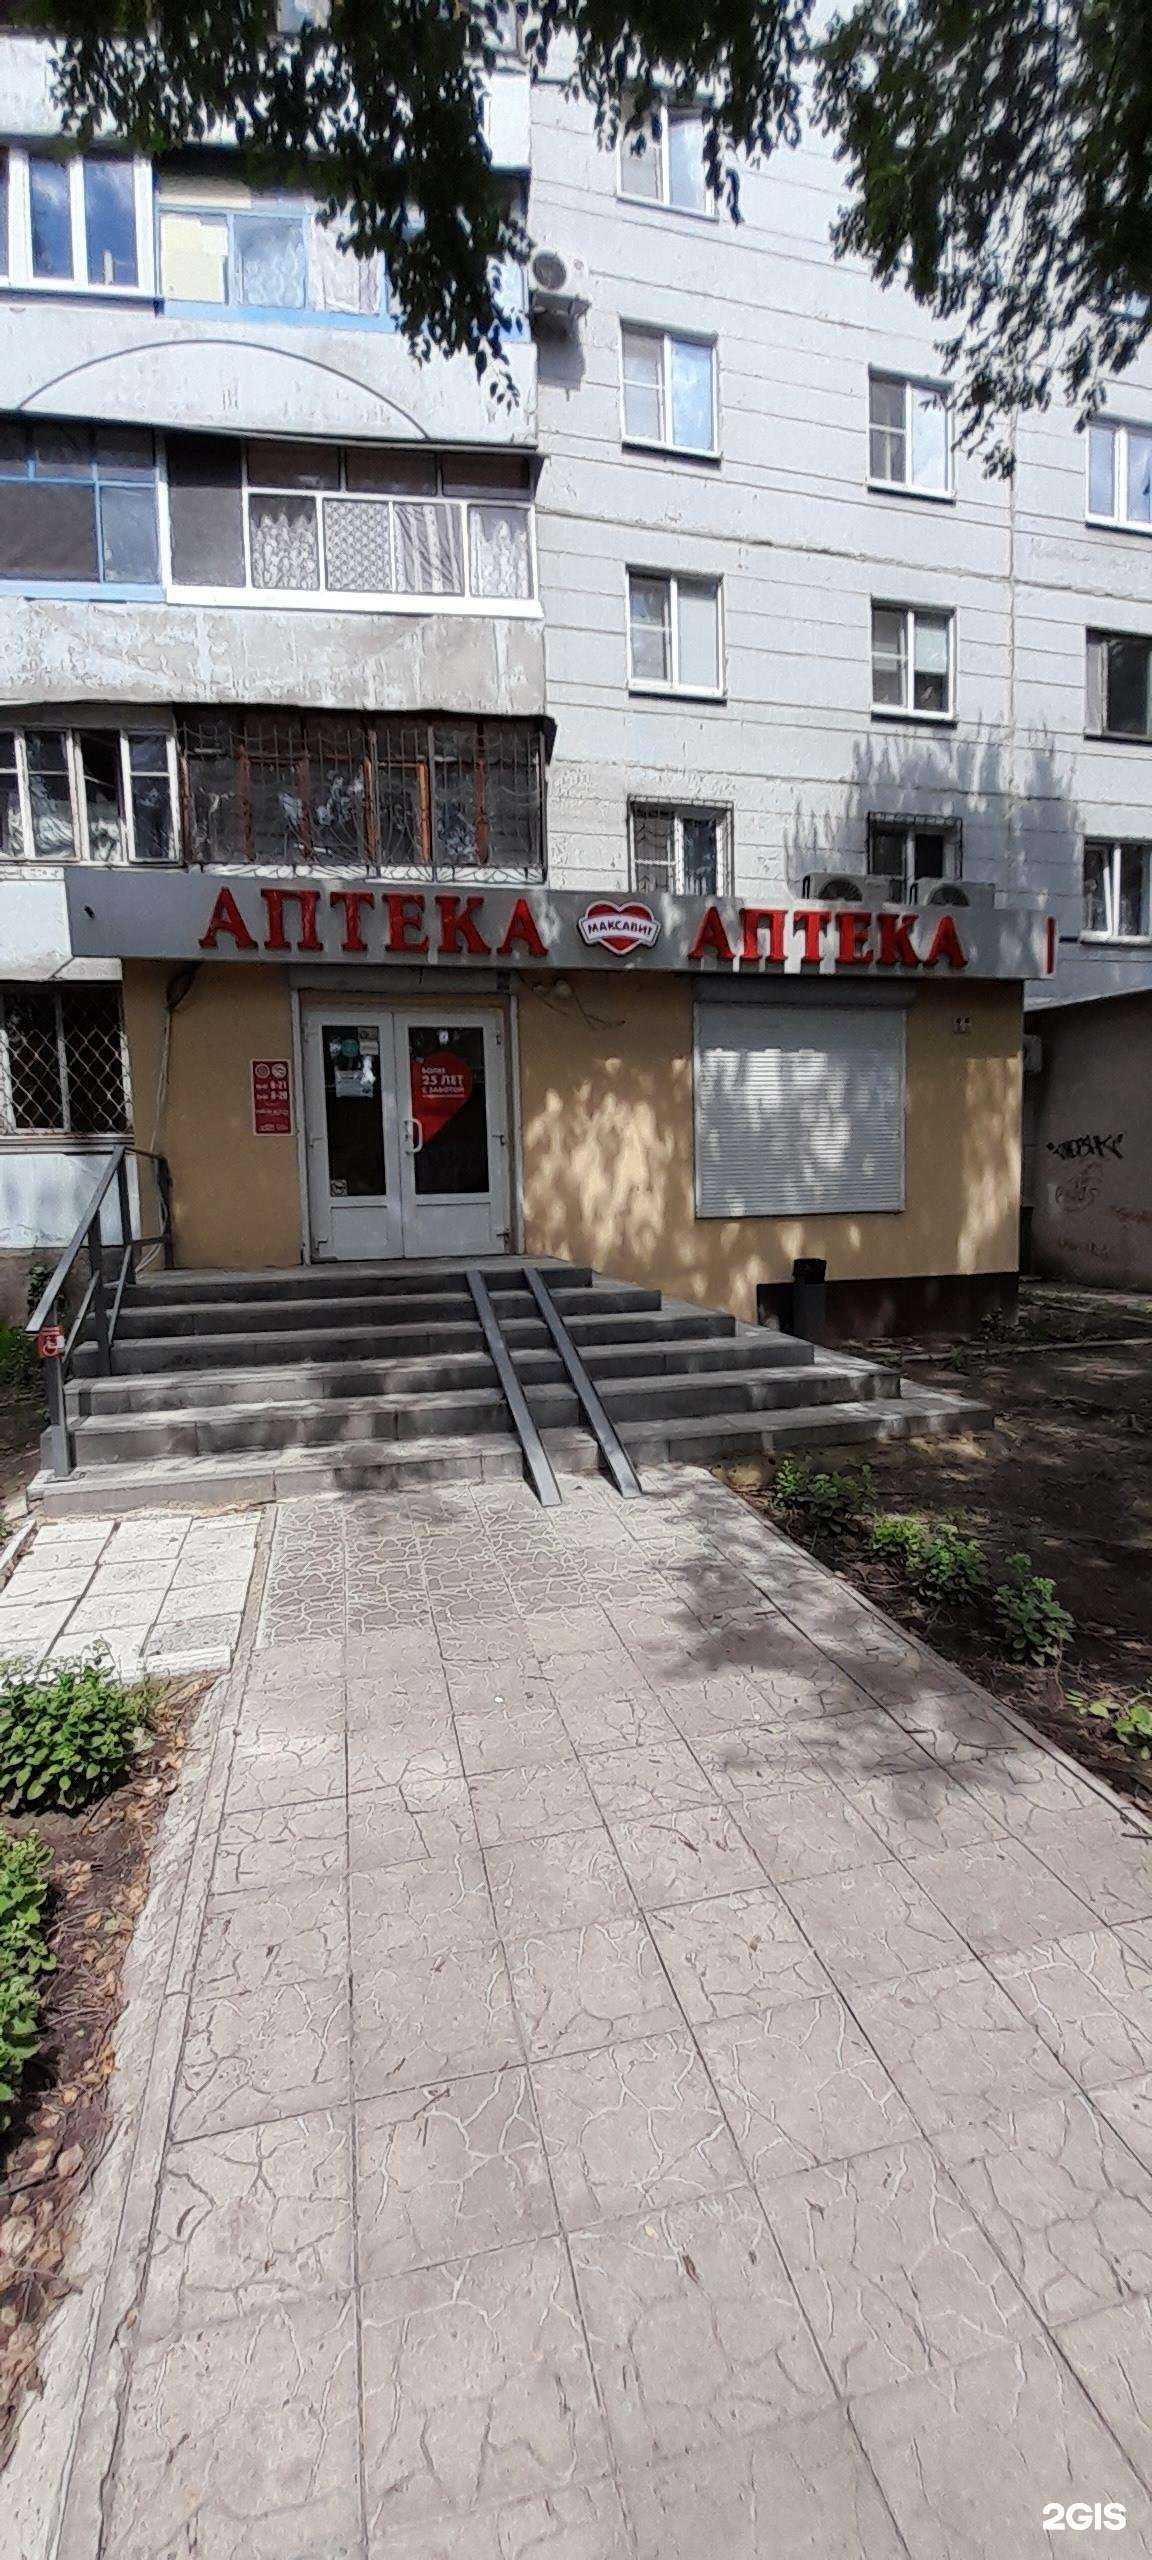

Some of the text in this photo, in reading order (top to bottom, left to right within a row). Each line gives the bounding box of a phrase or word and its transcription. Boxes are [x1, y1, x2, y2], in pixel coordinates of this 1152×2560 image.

[198, 886, 549, 957] АПТЕКА
[587, 919, 653, 936] МАКСАВИТ
[687, 905, 969, 968] АПТЕКА
[422, 1074, 465, 1086] 25 ЛЕТ
